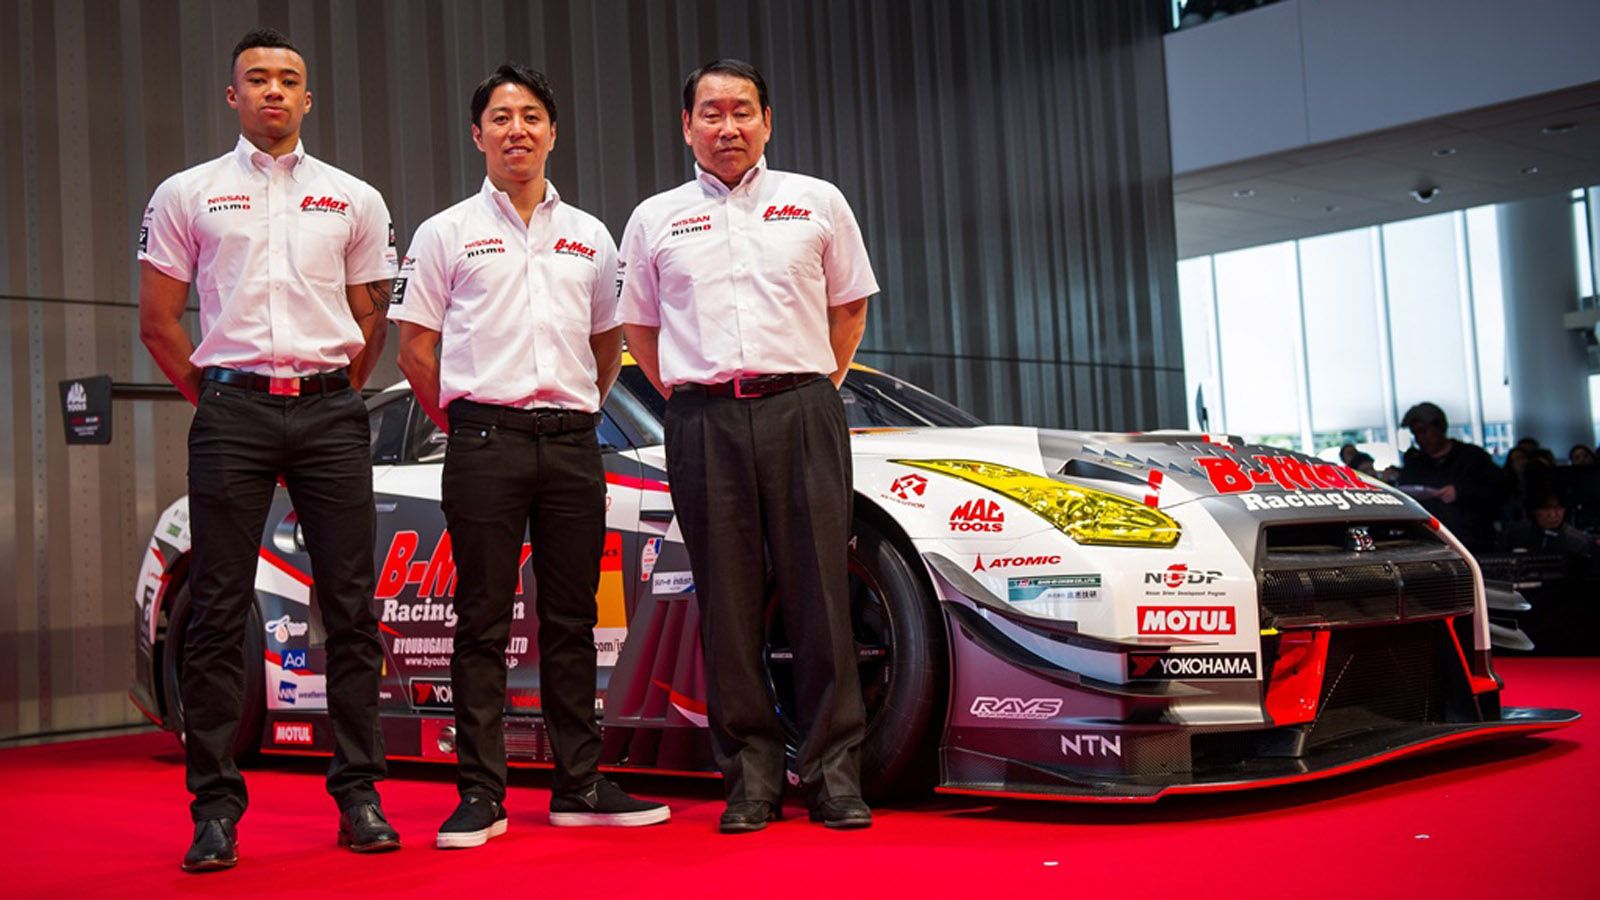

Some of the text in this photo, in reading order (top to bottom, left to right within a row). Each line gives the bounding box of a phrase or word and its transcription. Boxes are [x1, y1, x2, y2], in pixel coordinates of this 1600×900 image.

[208, 195, 250, 205] NISSAN
[300, 196, 349, 211] B-Max
[762, 204, 812, 218] B-Max
[671, 215, 710, 227] NISSAN
[465, 239, 503, 249] NISSAN
[553, 238, 596, 257] B-Max
[1194, 455, 1383, 494] B-Max
[949, 498, 1004, 522] MAC
[1241, 491, 1403, 511] Racing team
[949, 522, 1003, 533] TOOLS
[989, 556, 1061, 569] ATOMIC
[381, 597, 459, 627] Racing
[1141, 609, 1232, 632] MOTUL
[1159, 657, 1253, 675] YOKOHAMA
[970, 697, 1063, 716] RAYS
[275, 726, 311, 741] MOTUL
[1060, 735, 1121, 757] NTN
